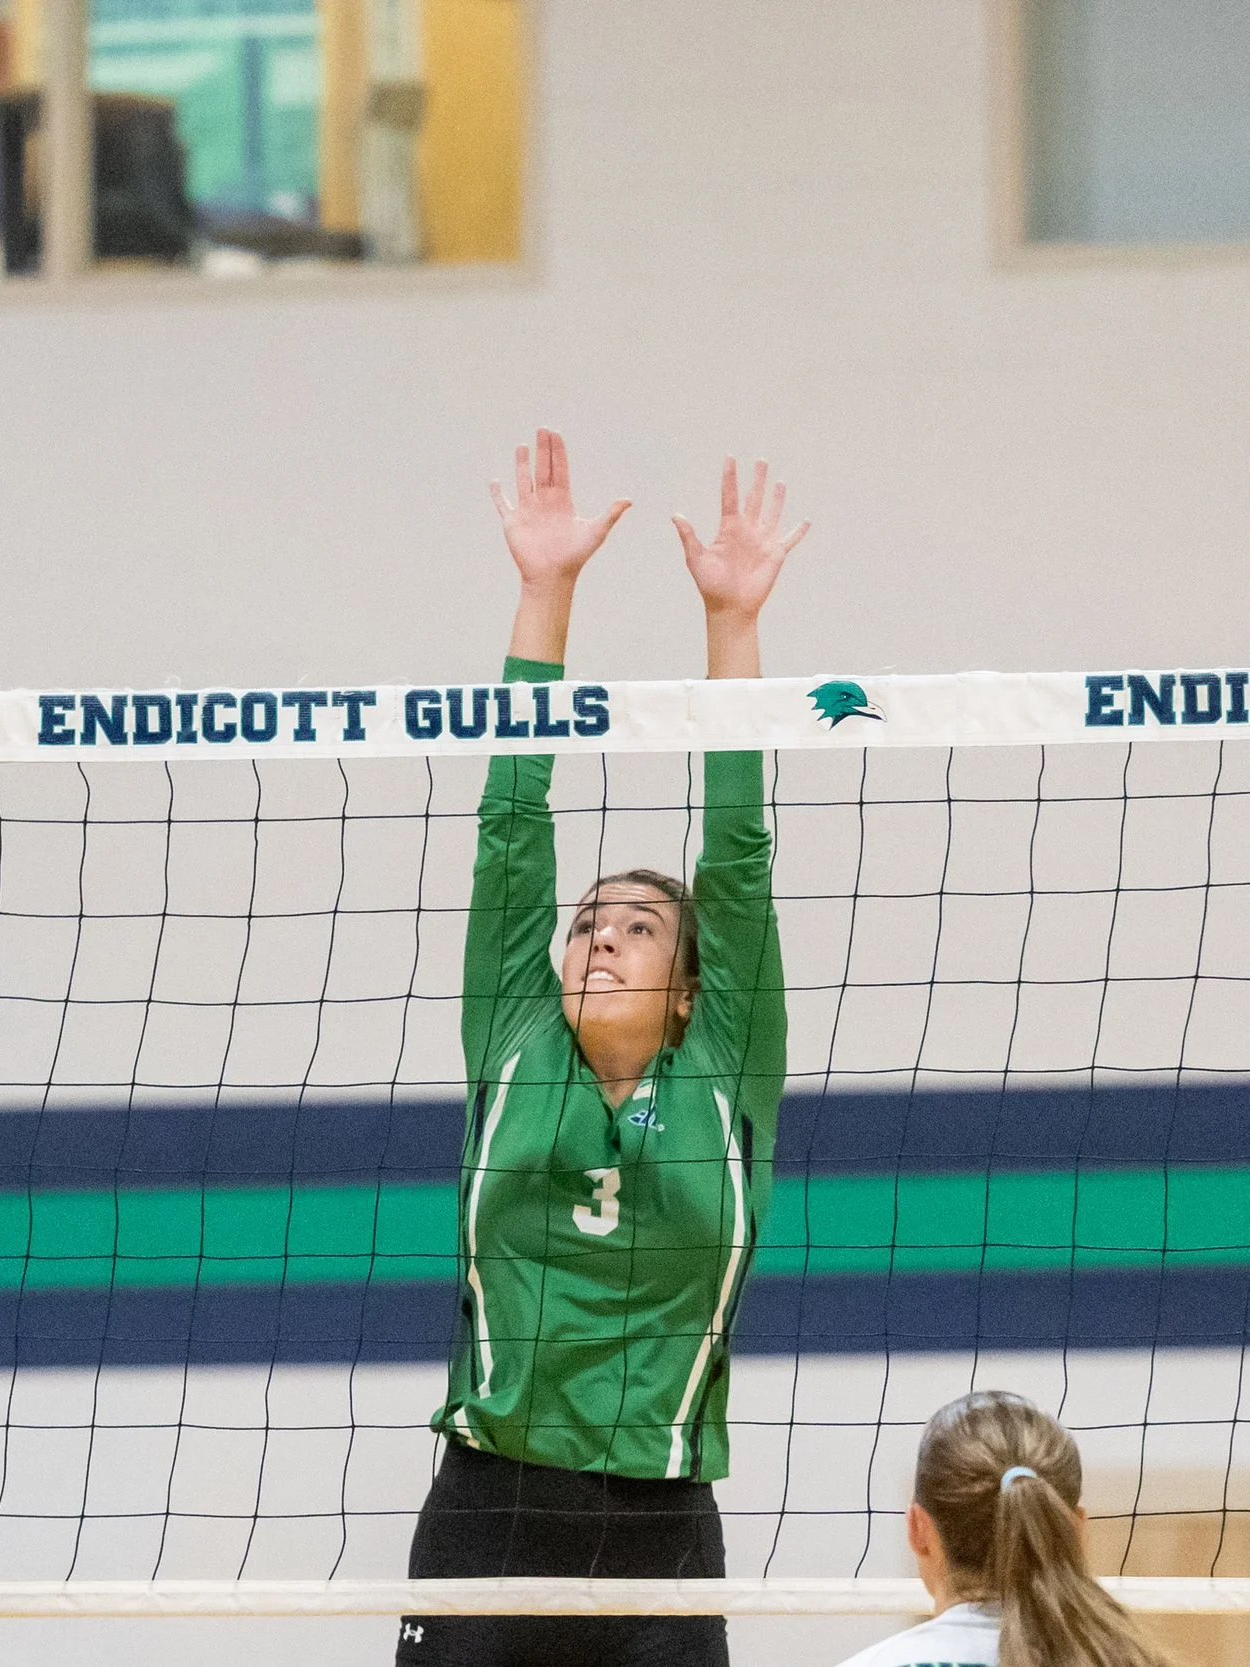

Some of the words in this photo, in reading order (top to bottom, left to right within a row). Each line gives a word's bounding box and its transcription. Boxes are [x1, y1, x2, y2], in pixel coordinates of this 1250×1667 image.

[38, 690, 376, 746] ENDICOTT
[405, 686, 610, 741] GULLS
[1085, 672, 1250, 726] ENDI
[572, 1167, 621, 1236] 3
